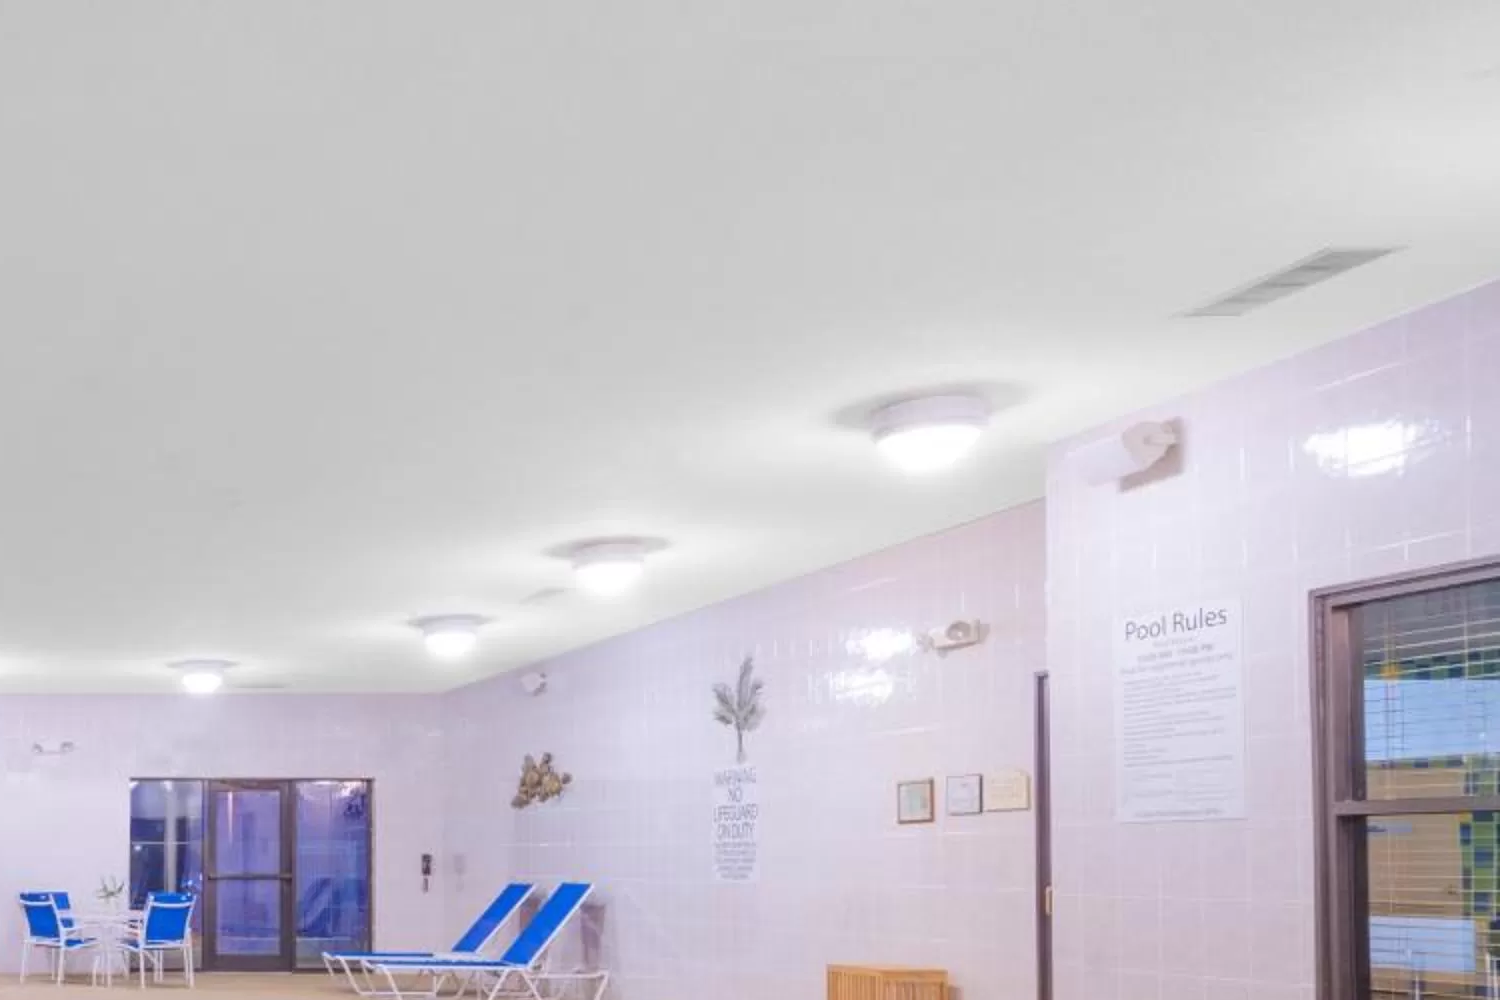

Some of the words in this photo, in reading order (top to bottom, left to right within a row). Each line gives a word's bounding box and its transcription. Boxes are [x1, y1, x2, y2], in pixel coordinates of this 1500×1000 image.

[1125, 615, 1167, 641] Pool
[1173, 607, 1228, 633] Rules
[727, 786, 743, 802] NO
[713, 803, 758, 822] LIFEGUARD
